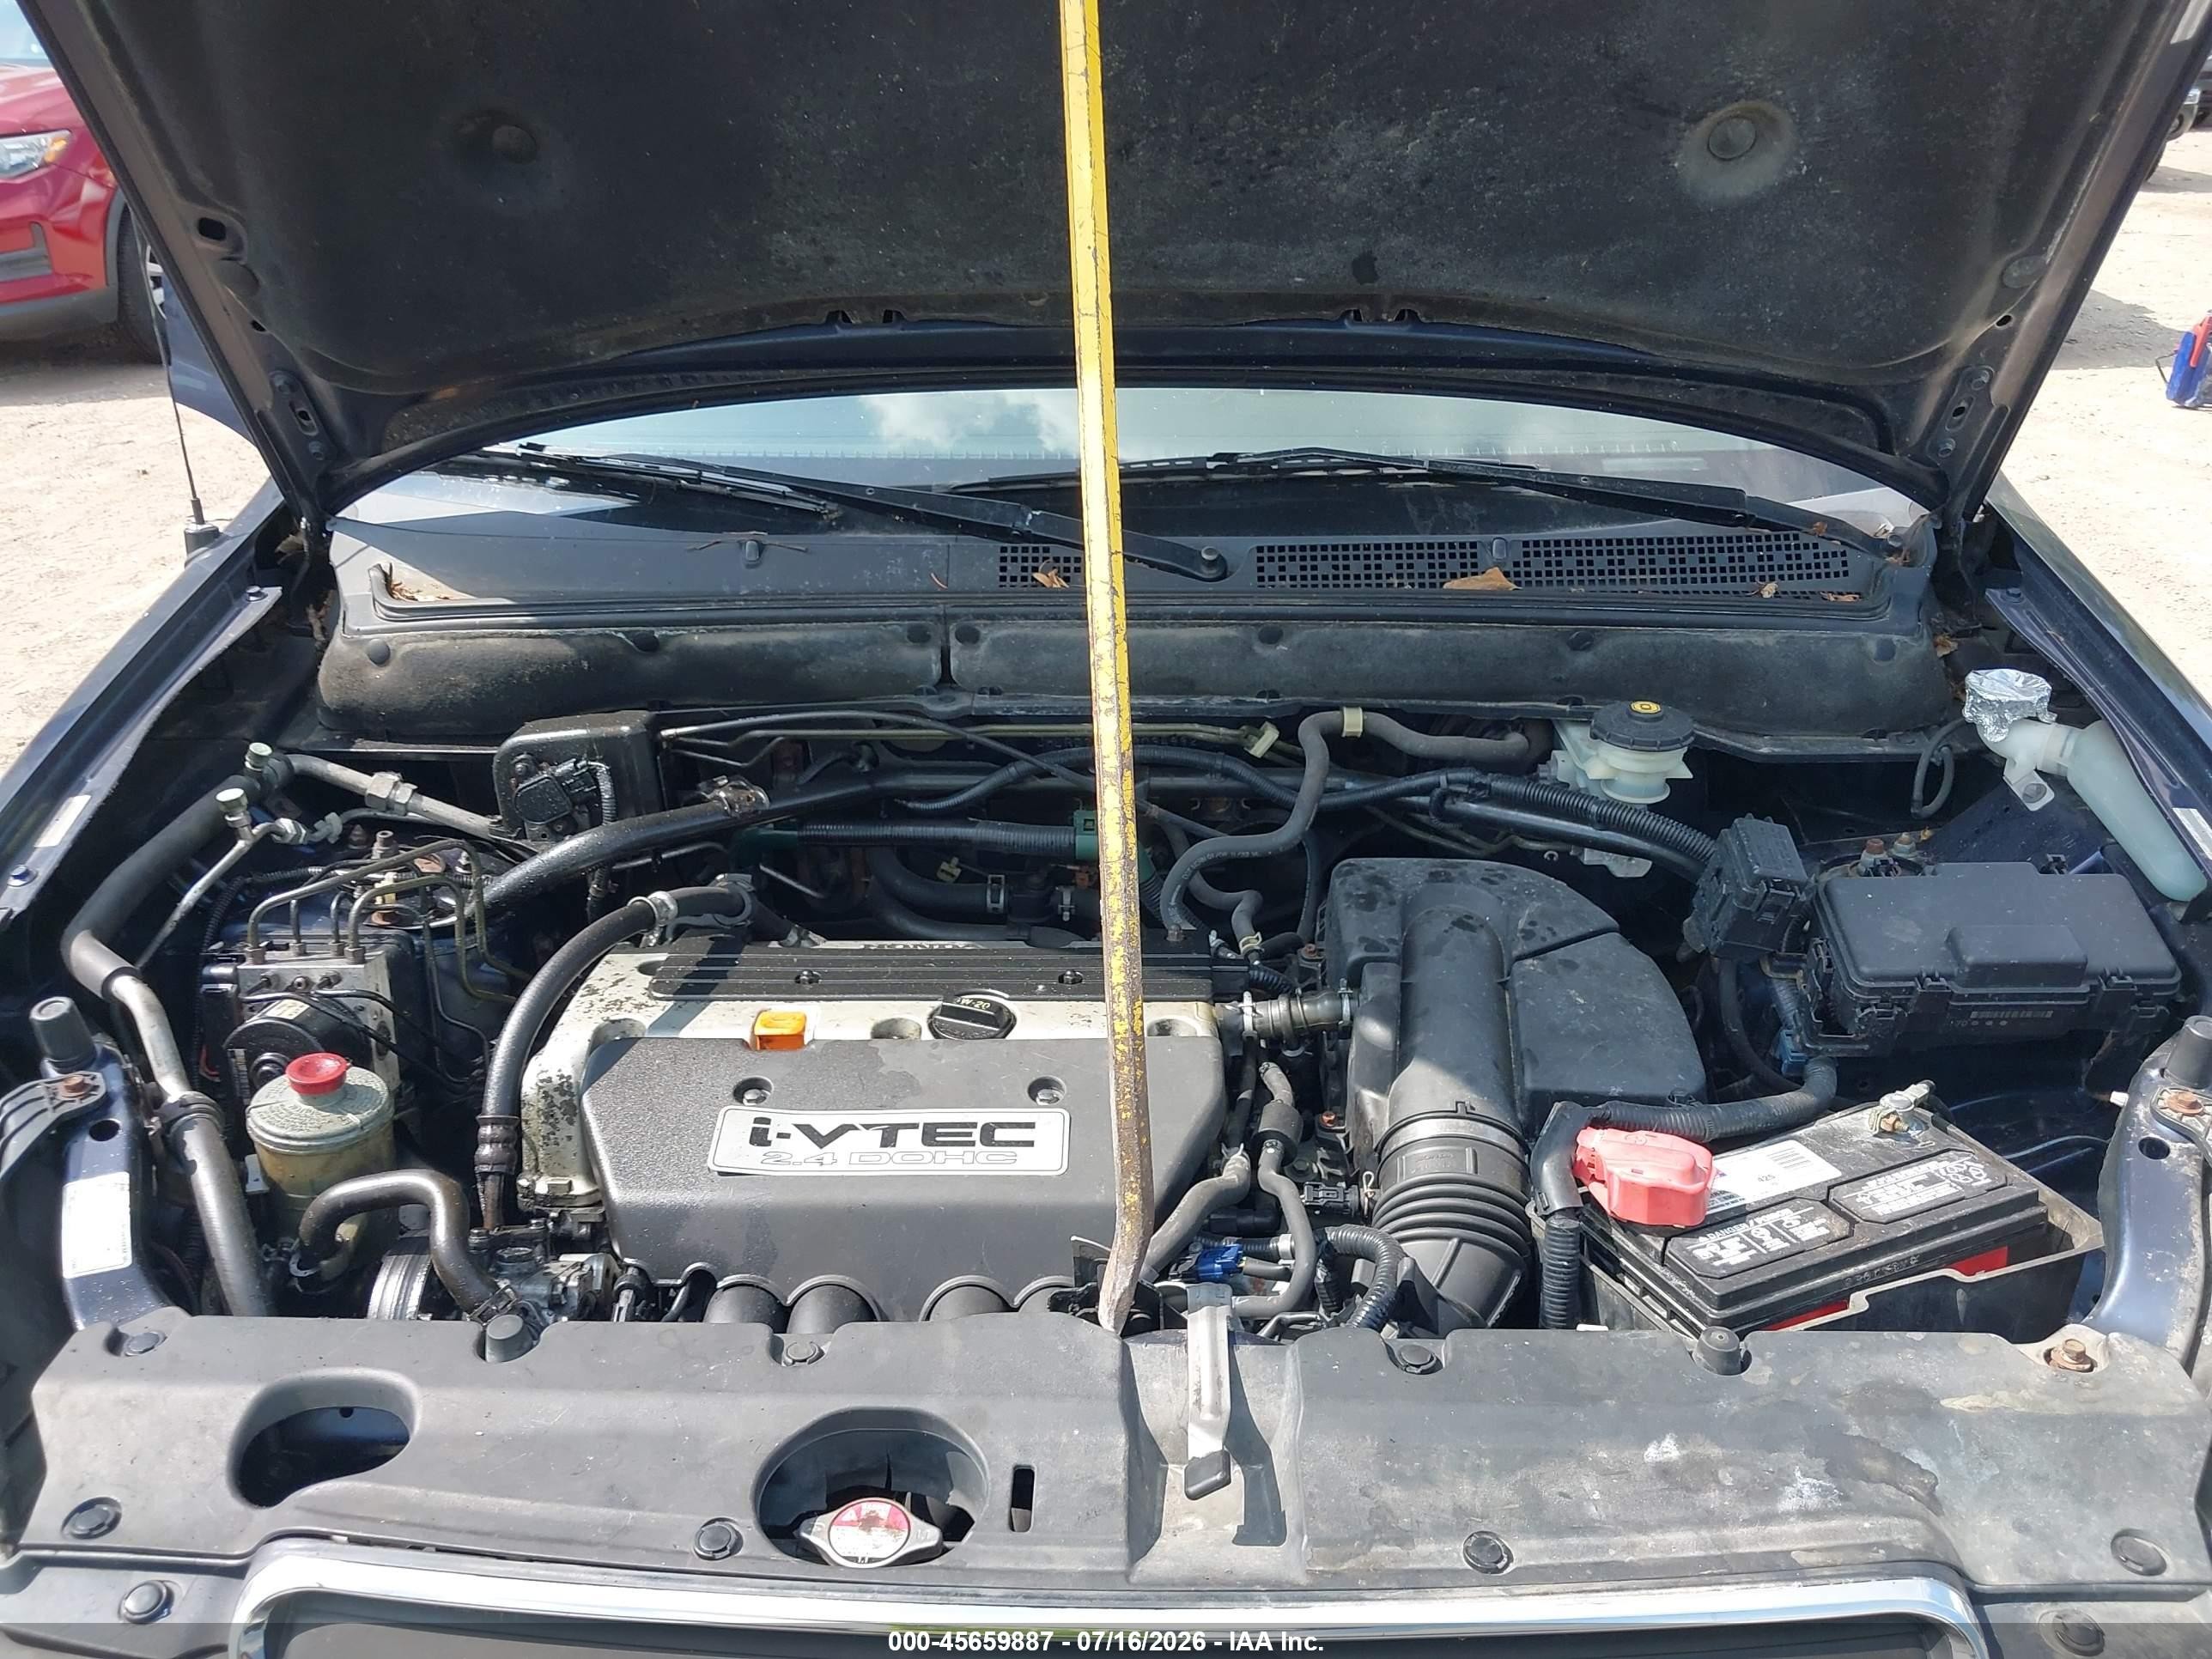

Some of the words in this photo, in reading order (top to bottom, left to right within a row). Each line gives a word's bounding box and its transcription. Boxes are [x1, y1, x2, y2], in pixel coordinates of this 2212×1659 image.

[749, 1116, 1036, 1149] i-VTEC
[760, 1151, 837, 1165] 2.4
[849, 1150, 1018, 1165] DOHC
